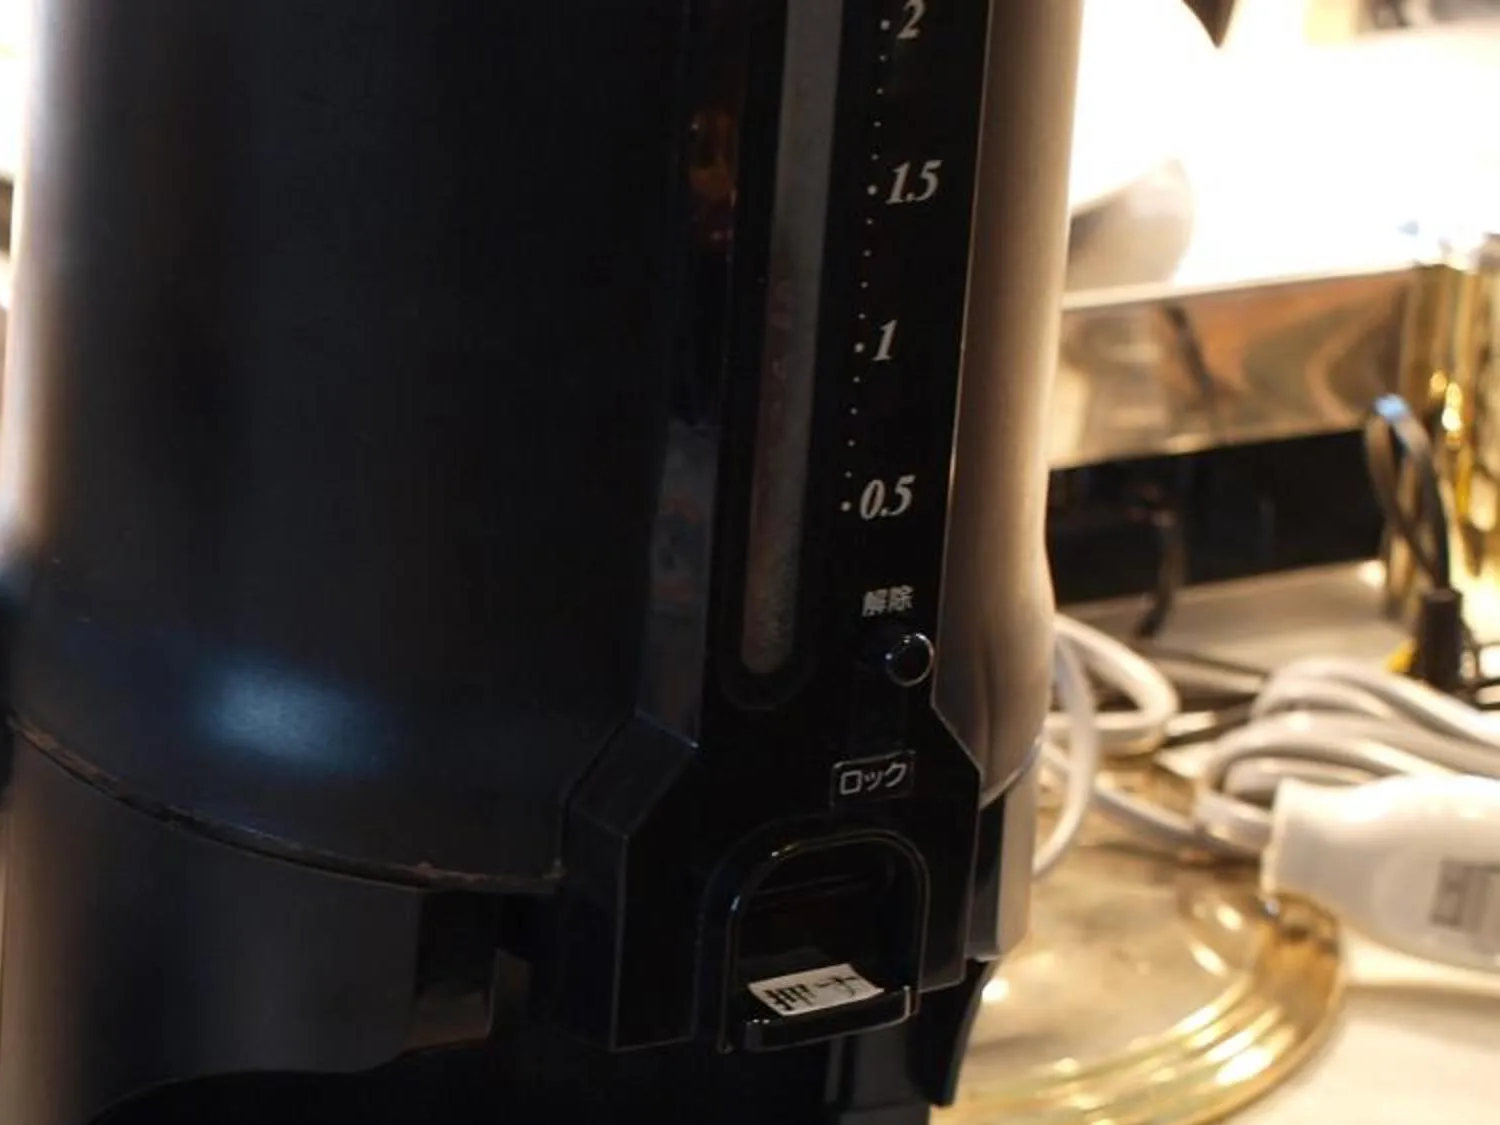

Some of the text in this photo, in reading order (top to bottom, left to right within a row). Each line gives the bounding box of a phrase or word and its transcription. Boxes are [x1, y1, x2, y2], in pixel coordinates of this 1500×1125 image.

[897, 0, 926, 39] 2
[886, 160, 943, 204] 1.5
[872, 320, 898, 361] 1
[859, 475, 916, 520] 0.5
[862, 585, 914, 617] 解除
[840, 762, 907, 795] ロック
